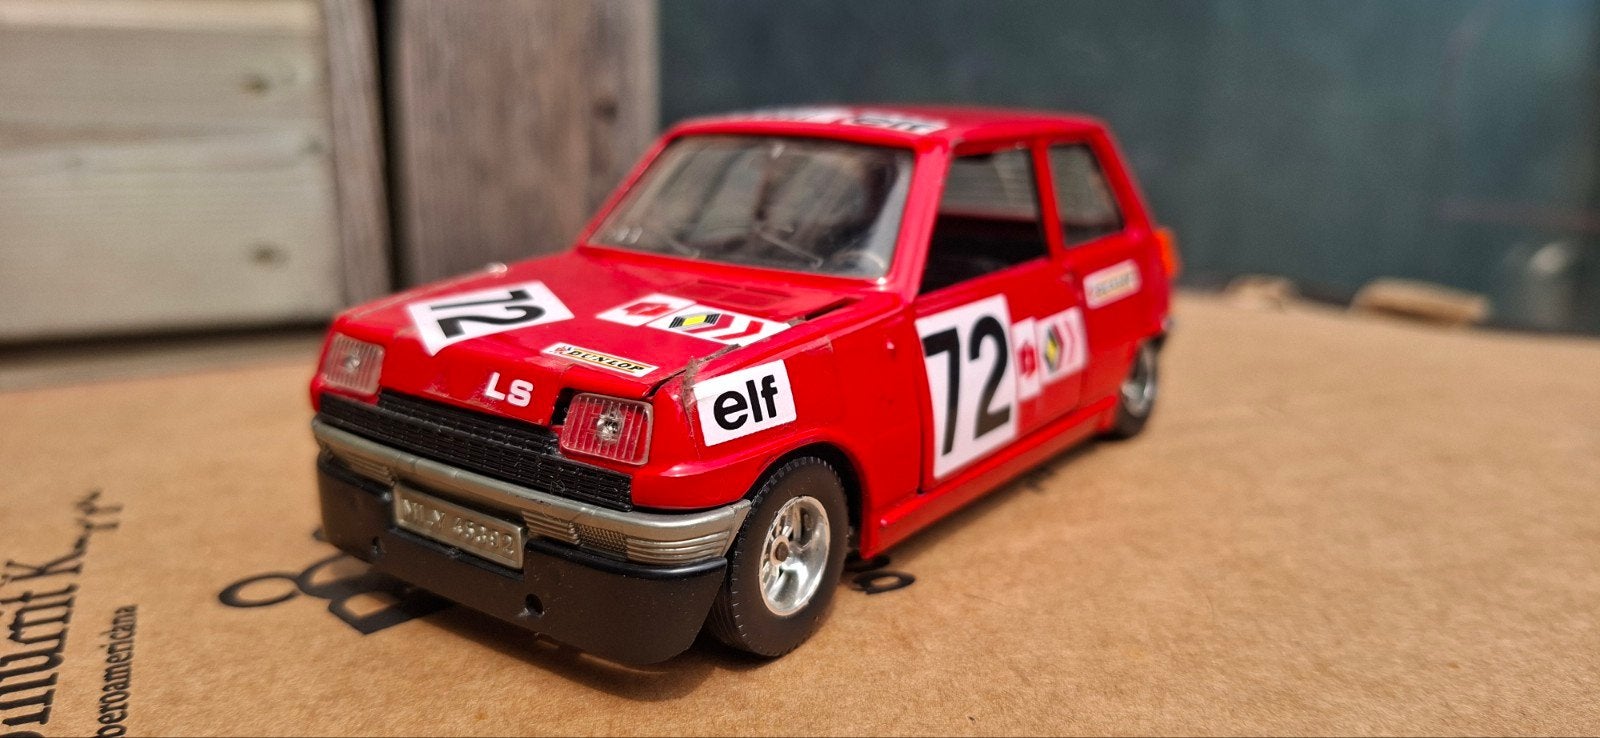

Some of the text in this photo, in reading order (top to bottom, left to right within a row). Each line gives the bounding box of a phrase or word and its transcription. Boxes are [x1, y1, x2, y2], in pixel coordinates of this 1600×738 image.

[429, 289, 546, 338] 72
[567, 348, 645, 373] DUNLOP
[485, 372, 534, 407] LS
[713, 374, 779, 431] elf
[922, 316, 1010, 456] 72
